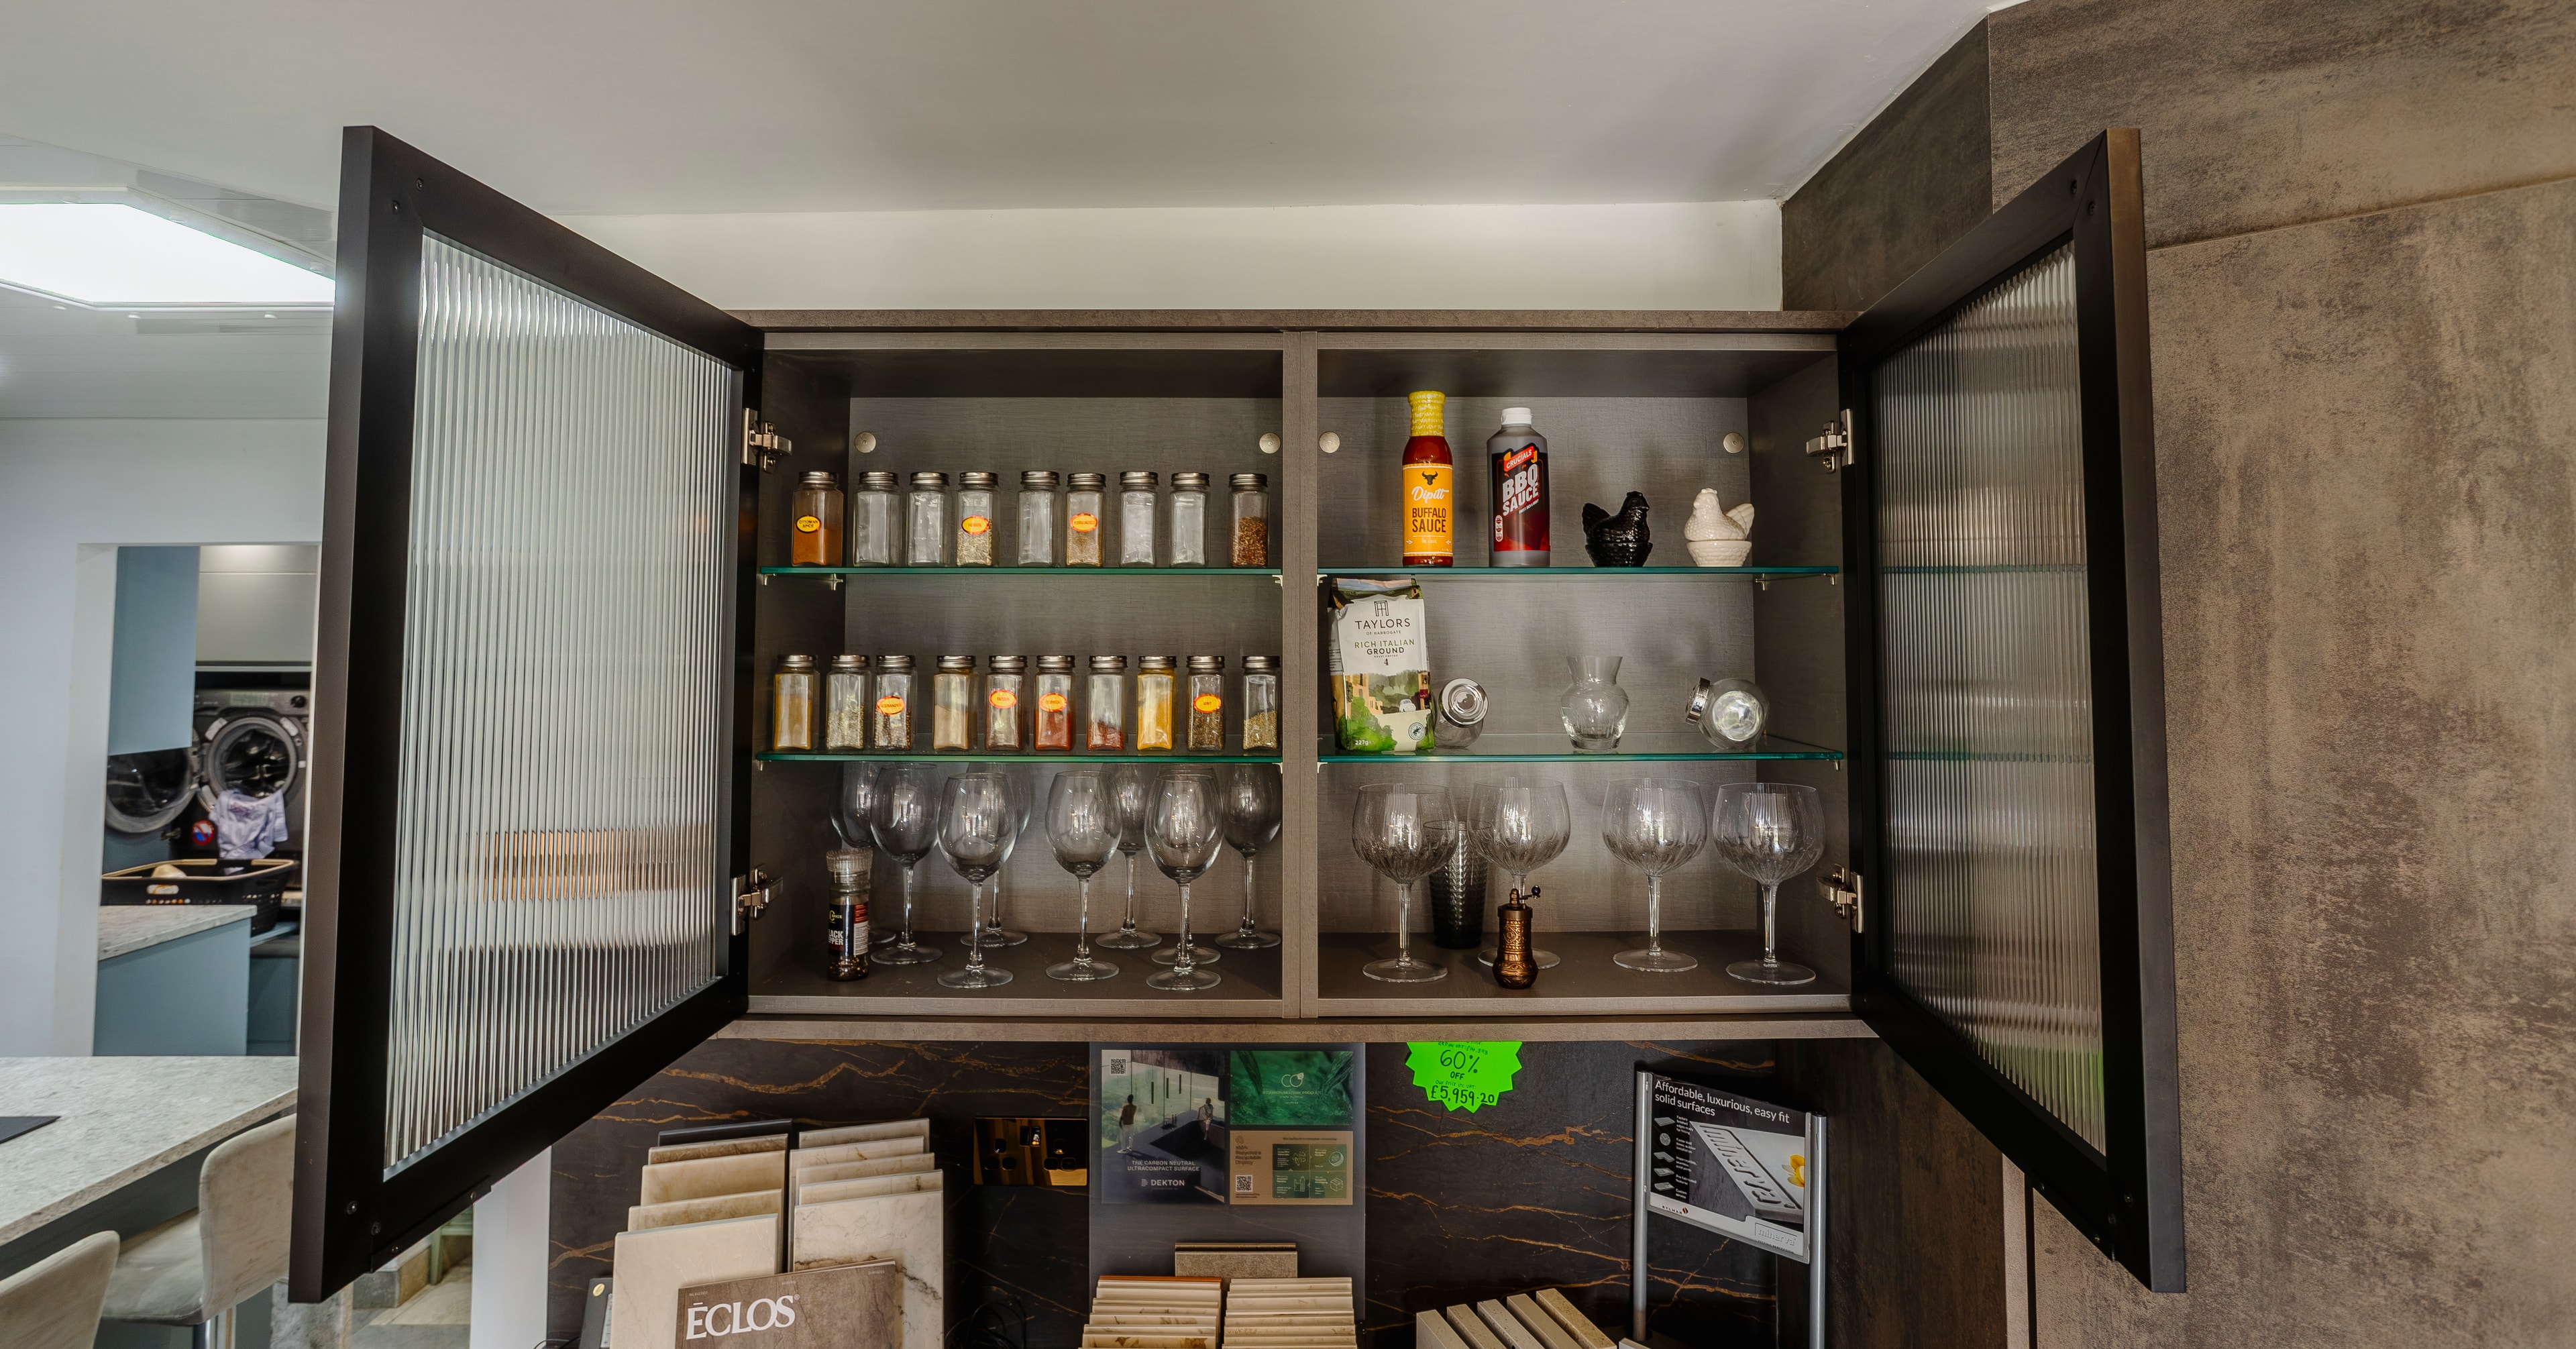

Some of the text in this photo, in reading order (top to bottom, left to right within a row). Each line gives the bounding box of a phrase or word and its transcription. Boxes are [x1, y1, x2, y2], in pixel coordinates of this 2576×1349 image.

[1506, 449, 1533, 469] CRUCIALS
[1502, 464, 1538, 503] BBQ
[1503, 482, 1539, 517] SAUCE
[1412, 507, 1446, 519] BUFFALO
[1412, 519, 1446, 533] SAUCE
[1354, 618, 1411, 630] TAYLORS
[1354, 639, 1415, 649] RICH ITALIAN
[1366, 647, 1405, 655] GROUND
[1384, 658, 1389, 666] 4
[1440, 1049, 1481, 1073] 60%
[1450, 1071, 1466, 1081] OFF
[1655, 1080, 1790, 1124] Affordable, luxurious, easy fit
[1655, 1093, 1715, 1116] solid surfaces
